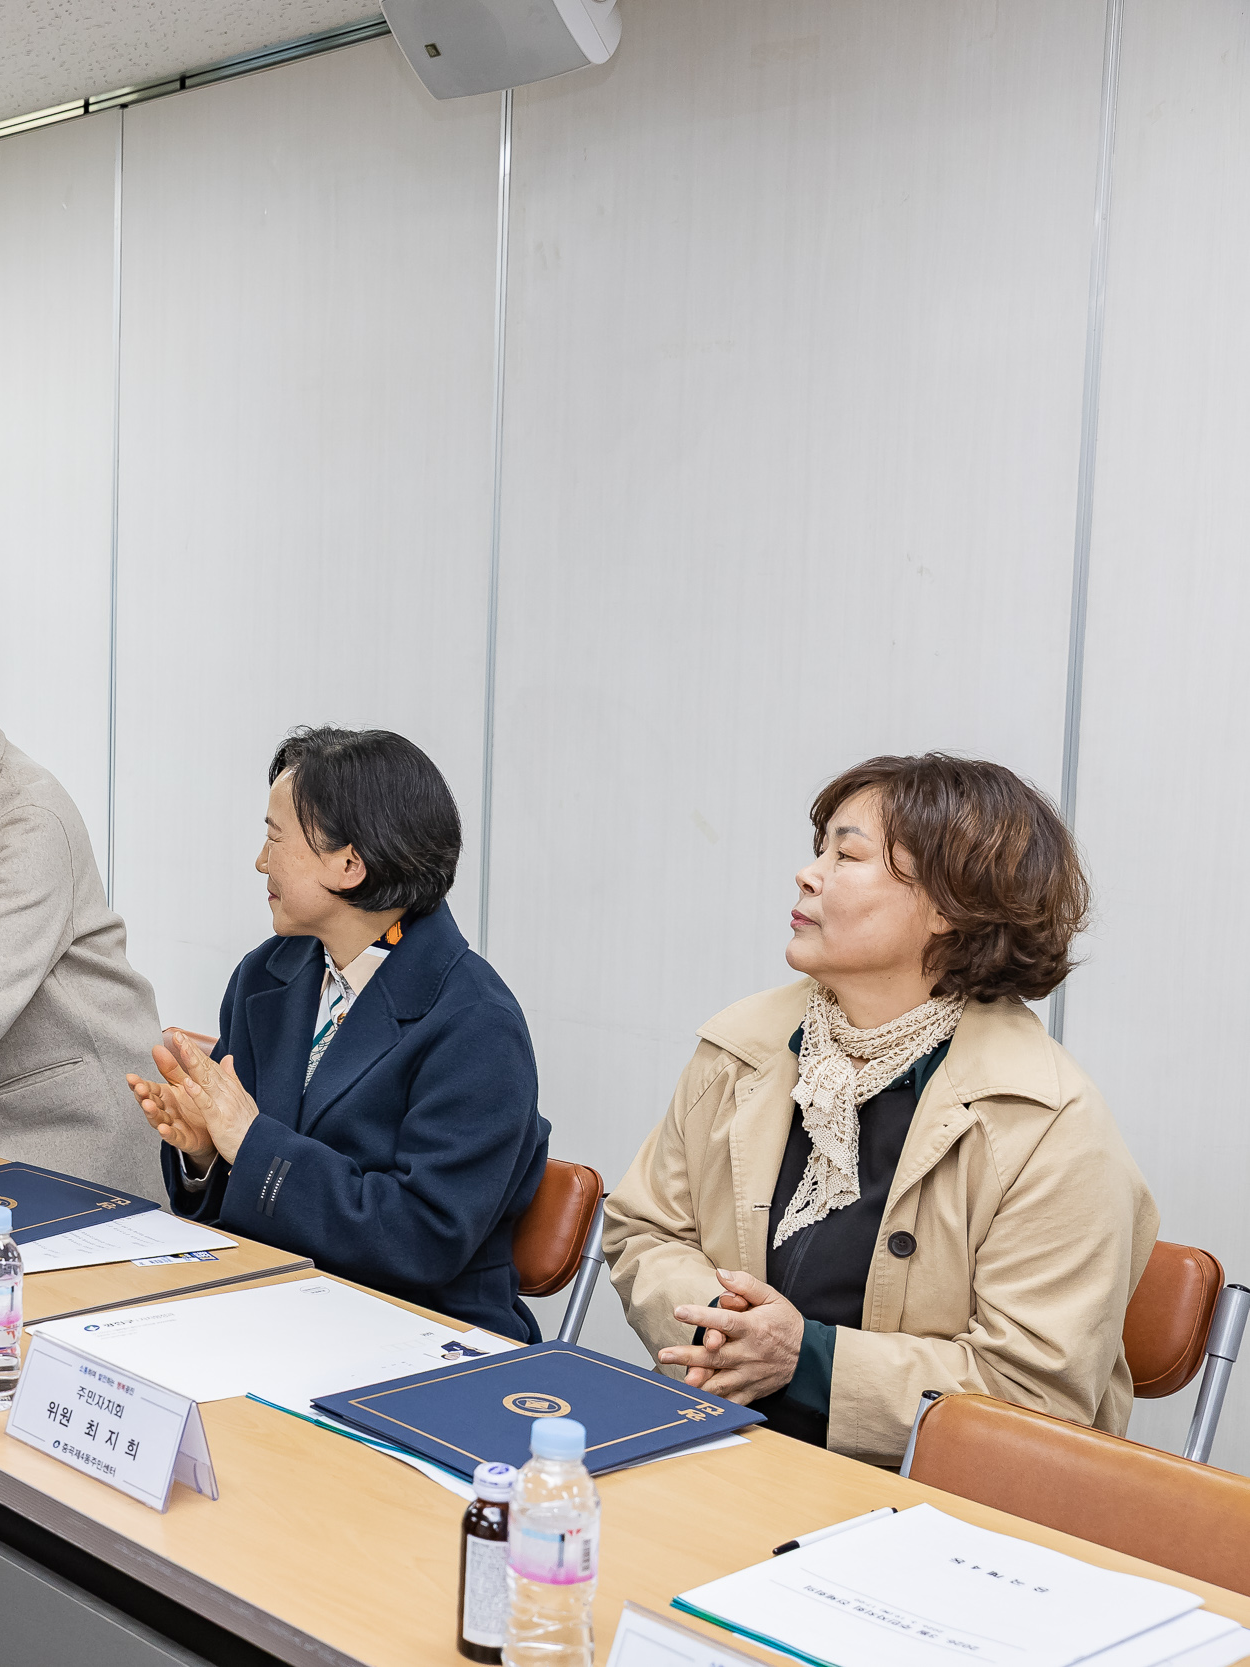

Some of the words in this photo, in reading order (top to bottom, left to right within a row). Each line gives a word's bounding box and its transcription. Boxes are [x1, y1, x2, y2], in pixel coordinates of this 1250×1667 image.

[47, 1401, 73, 1428] 위원
[84, 1419, 100, 1441] 최
[104, 1429, 120, 1451] 지
[124, 1438, 140, 1461] 희
